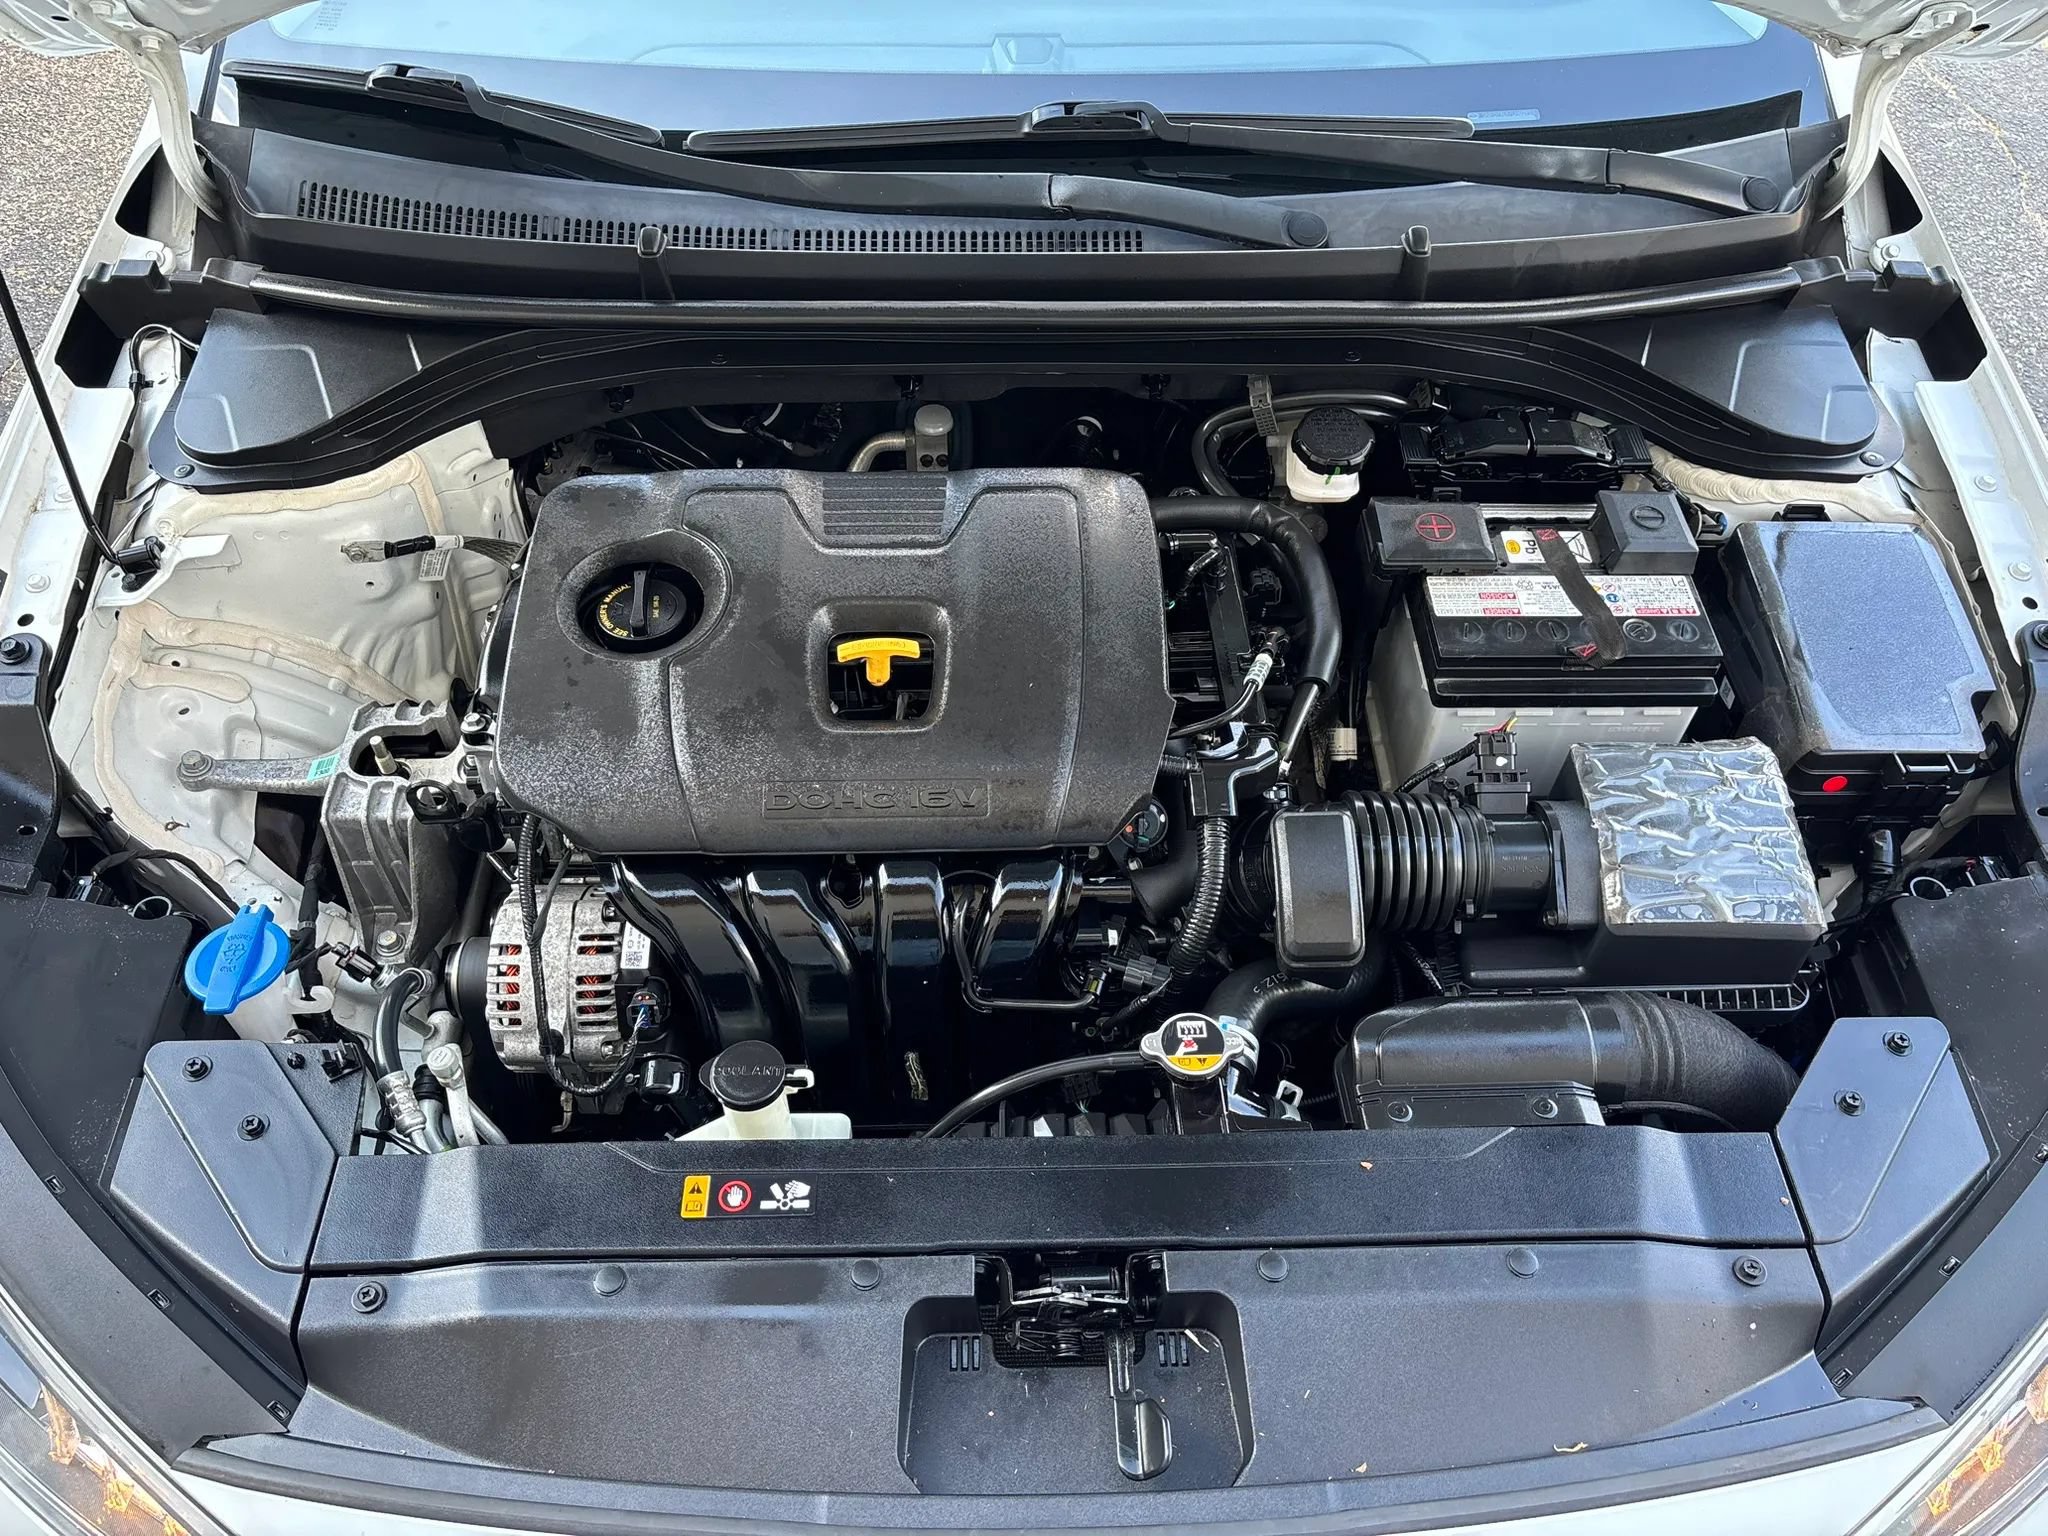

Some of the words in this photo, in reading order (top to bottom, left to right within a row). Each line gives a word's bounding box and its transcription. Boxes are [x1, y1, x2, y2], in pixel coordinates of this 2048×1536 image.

[1522, 539, 1538, 554] Pb
[603, 584, 632, 603] MANUAL
[613, 627, 629, 636] SEE
[766, 789, 897, 810] DOHC
[910, 788, 978, 809] 16V
